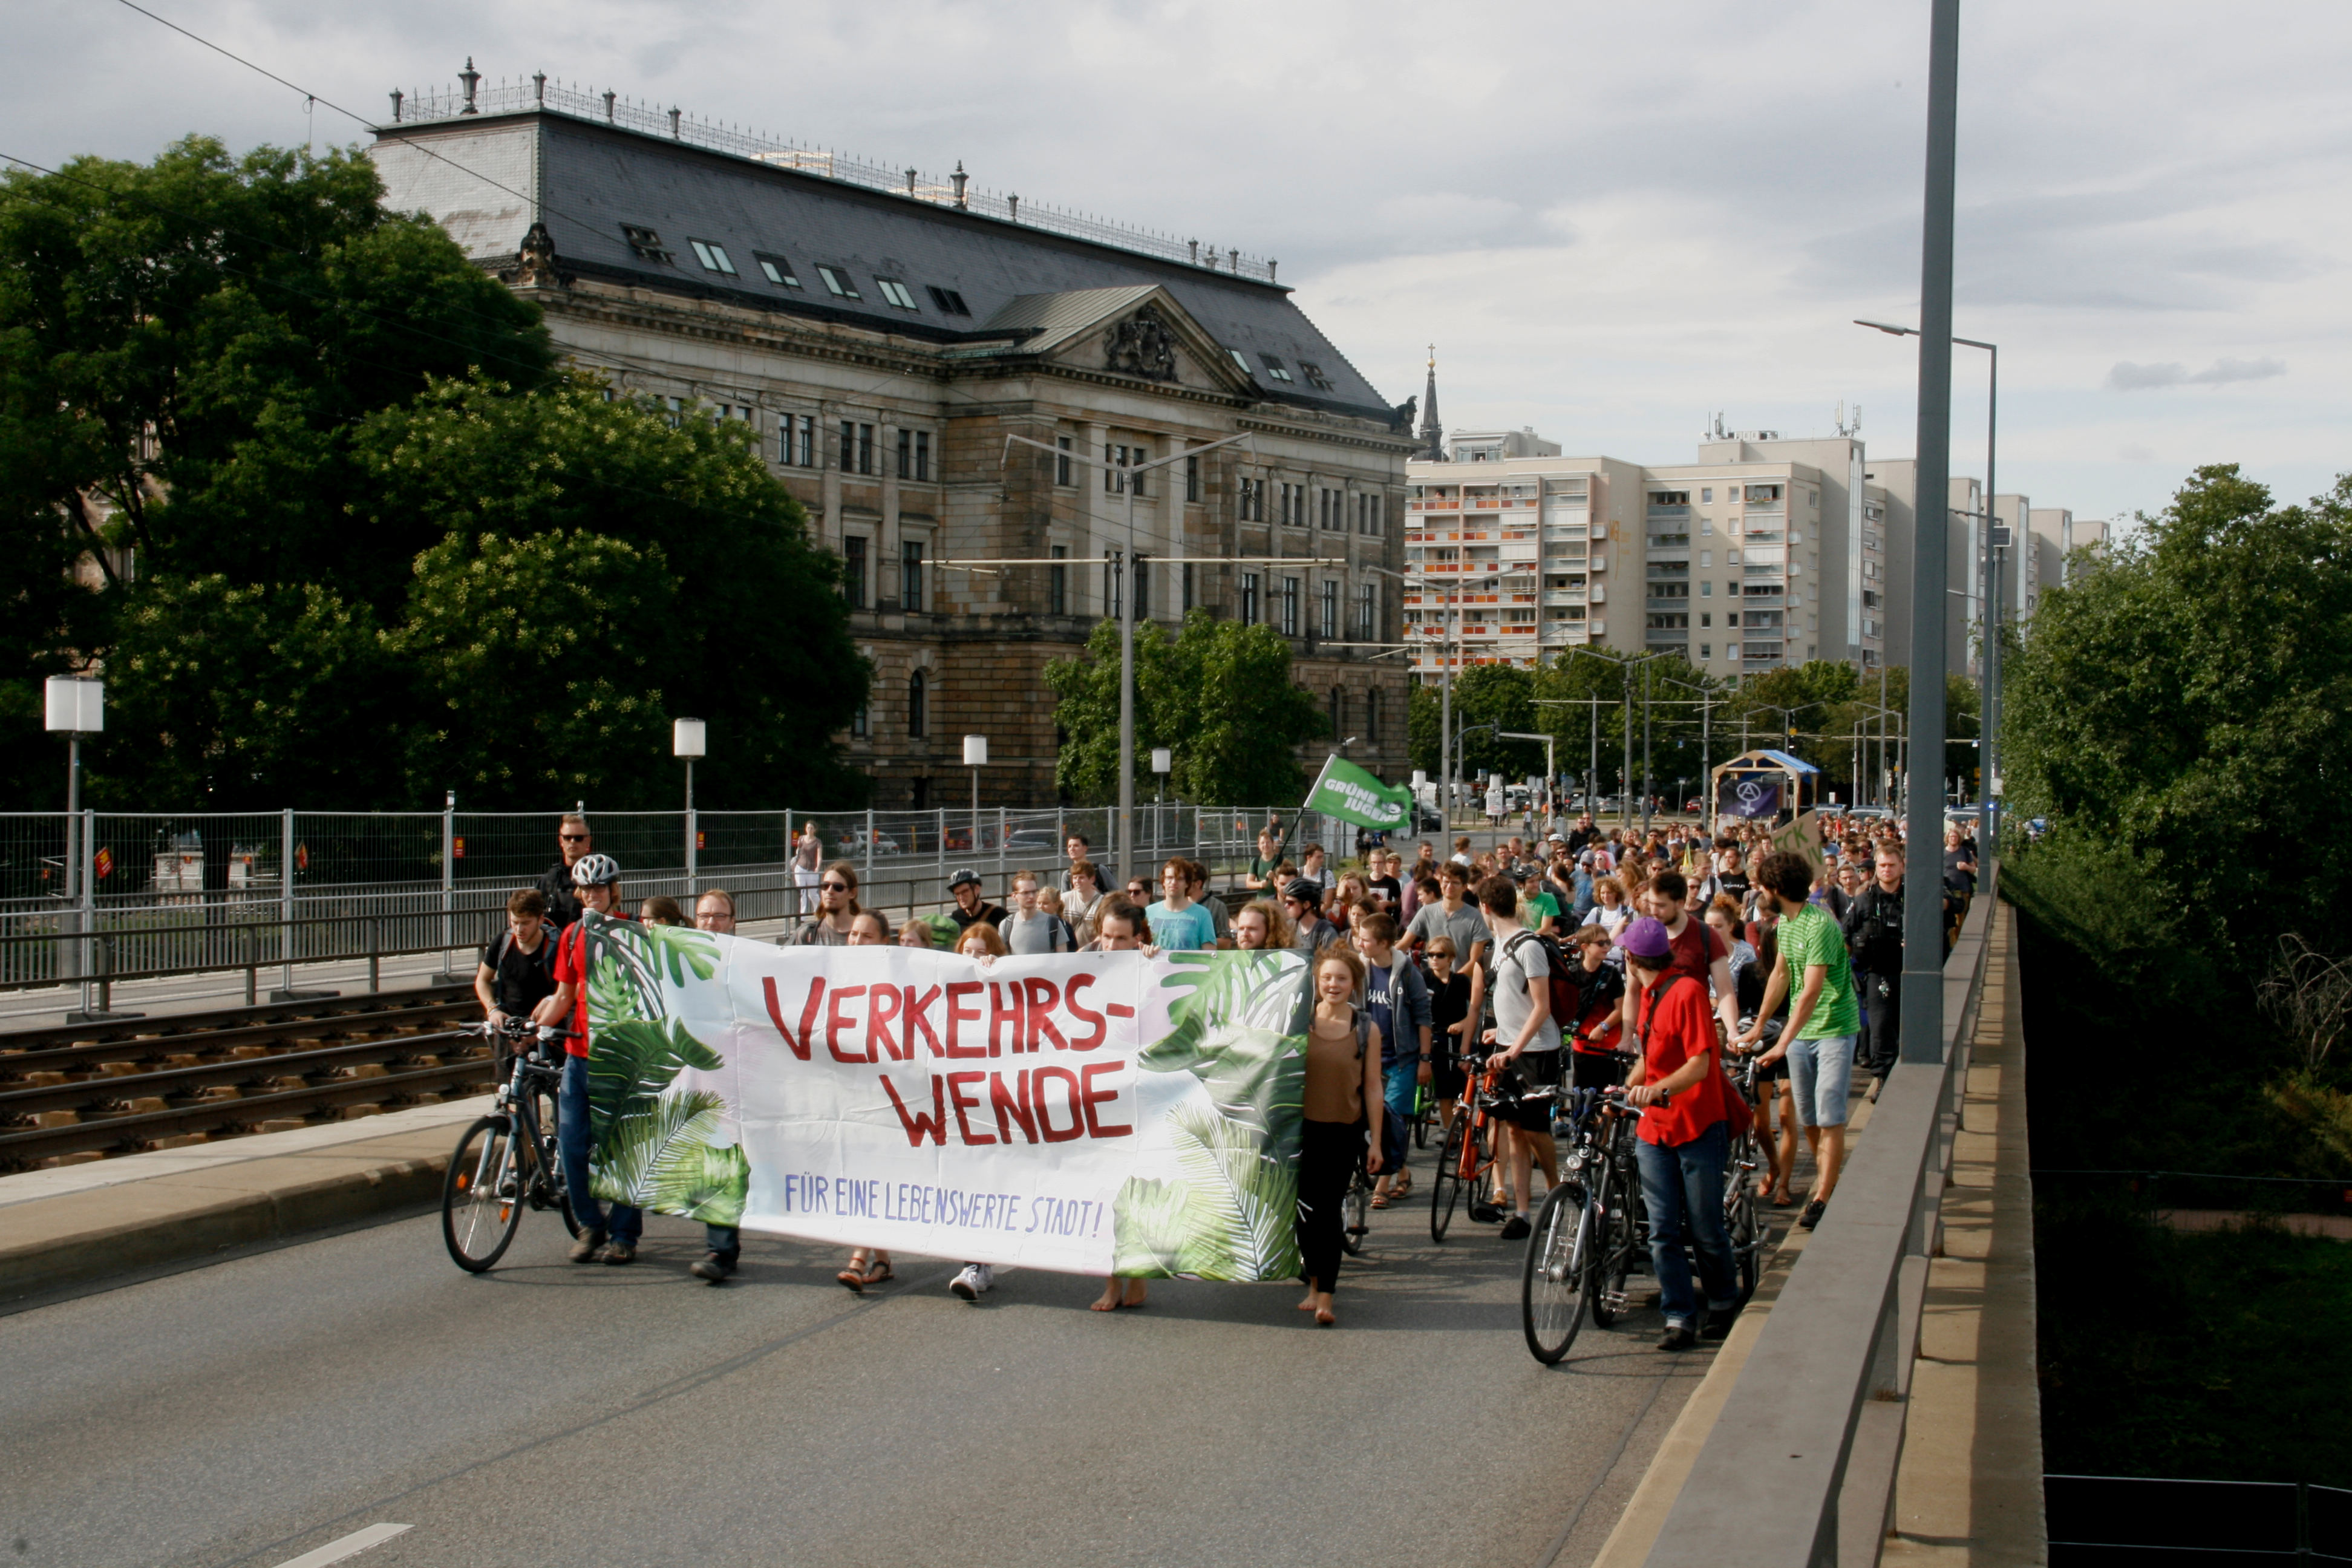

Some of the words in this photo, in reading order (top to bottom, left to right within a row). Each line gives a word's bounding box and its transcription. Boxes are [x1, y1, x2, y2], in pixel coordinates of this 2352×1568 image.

[1324, 778, 1379, 806] GRÜNE
[1774, 822, 1809, 852] FCK
[762, 973, 1135, 1063] VERKEHRS-
[878, 1060, 1134, 1148] WENDE
[785, 1171, 829, 1214] FÜR
[835, 1177, 880, 1219] EINE
[884, 1181, 1022, 1231] LEBENSWERTE
[1024, 1196, 1103, 1238] STADT!
